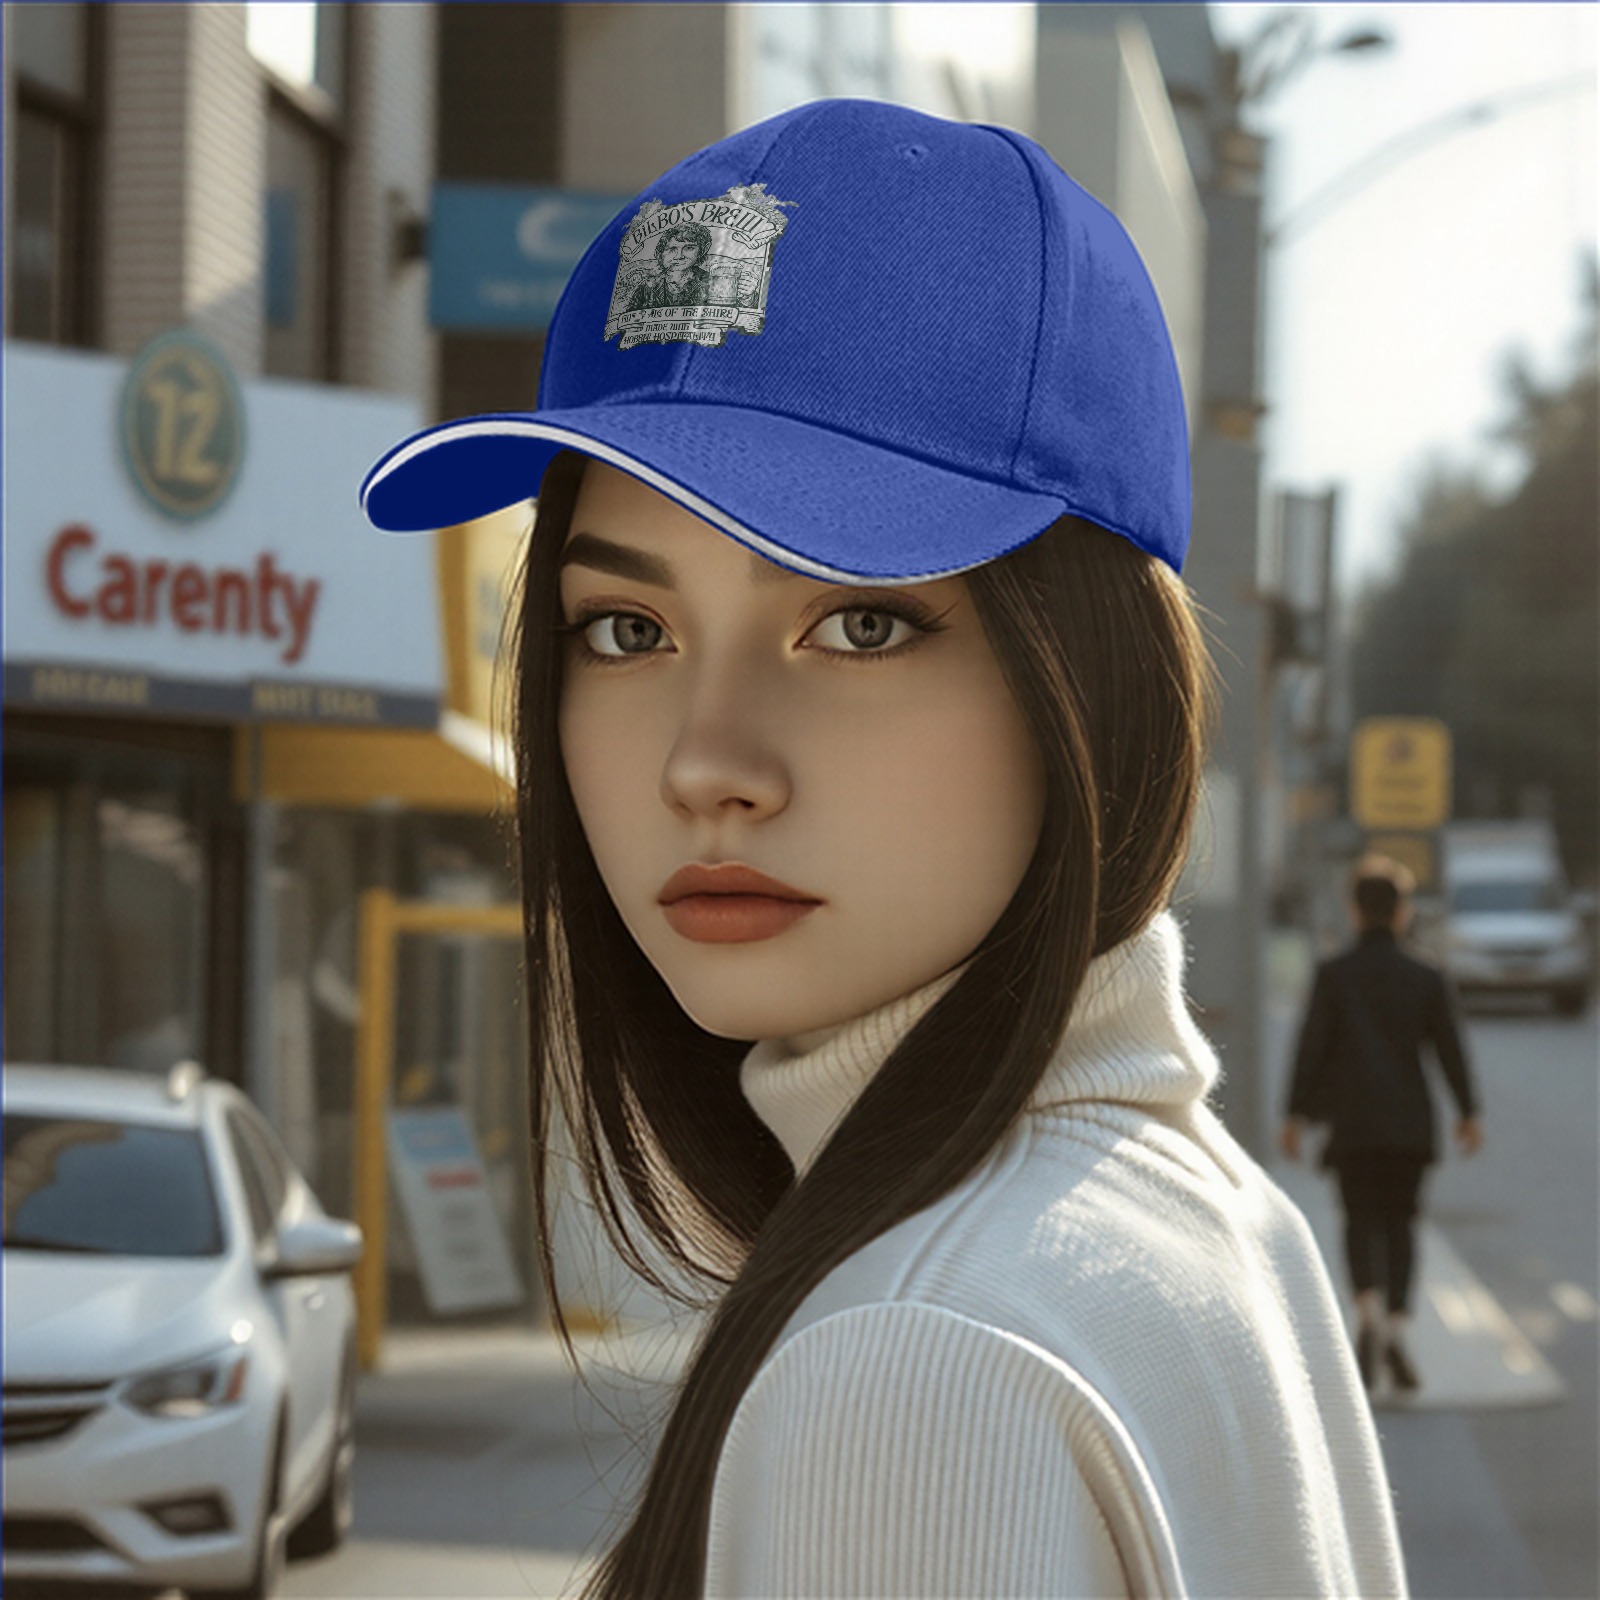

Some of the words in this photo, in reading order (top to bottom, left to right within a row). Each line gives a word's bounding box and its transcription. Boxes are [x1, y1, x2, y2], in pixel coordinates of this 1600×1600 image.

[665, 308, 678, 317] OF
[701, 308, 734, 318] SHIRE
[44, 522, 322, 664] Carenty
